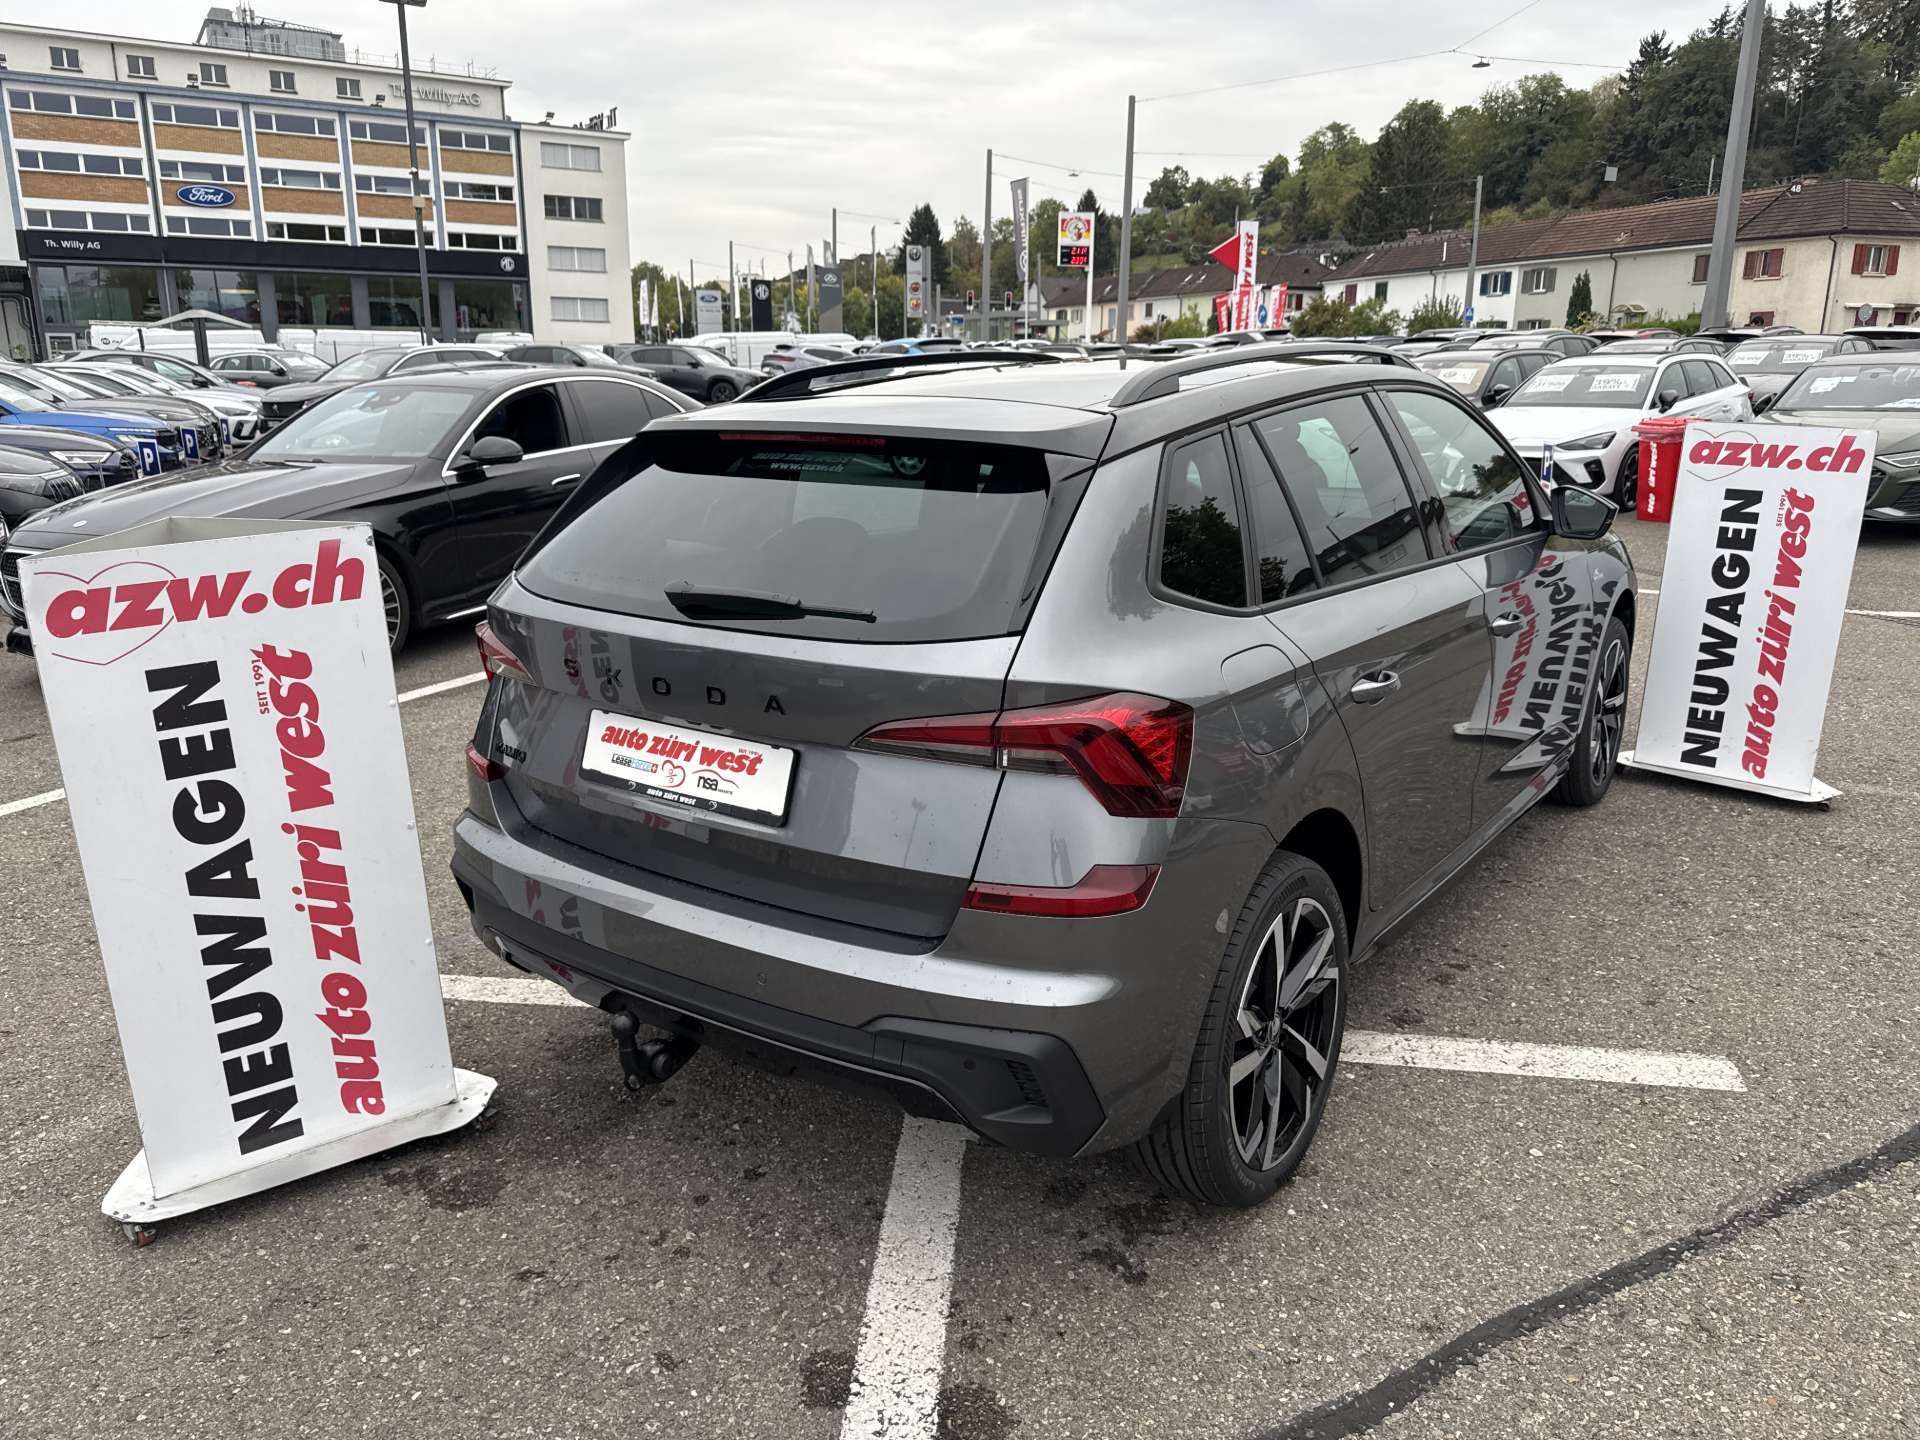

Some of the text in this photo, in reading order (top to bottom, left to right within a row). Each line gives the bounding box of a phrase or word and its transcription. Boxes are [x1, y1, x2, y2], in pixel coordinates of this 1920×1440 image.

[418, 86, 454, 106] Willy
[459, 91, 481, 106] AG
[189, 187, 224, 203] Ford
[1791, 184, 1802, 193] 48
[44, 239, 101, 251] Th. Willy AG
[754, 283, 770, 301] MG
[185, 433, 194, 455] P
[1689, 435, 1866, 474] azw.ch
[143, 447, 154, 472] P
[45, 538, 365, 639] azw.ch
[1680, 487, 1764, 769] NEUWAGEN
[1742, 487, 1815, 780] auto züri west
[251, 659, 270, 715] SEIT 1991
[600, 725, 764, 776] auto züri west
[697, 775, 719, 792] nsa
[646, 788, 696, 806] auto züri west
[249, 643, 385, 1117] auto züri west
[145, 658, 305, 1156] NEUWAGEN
